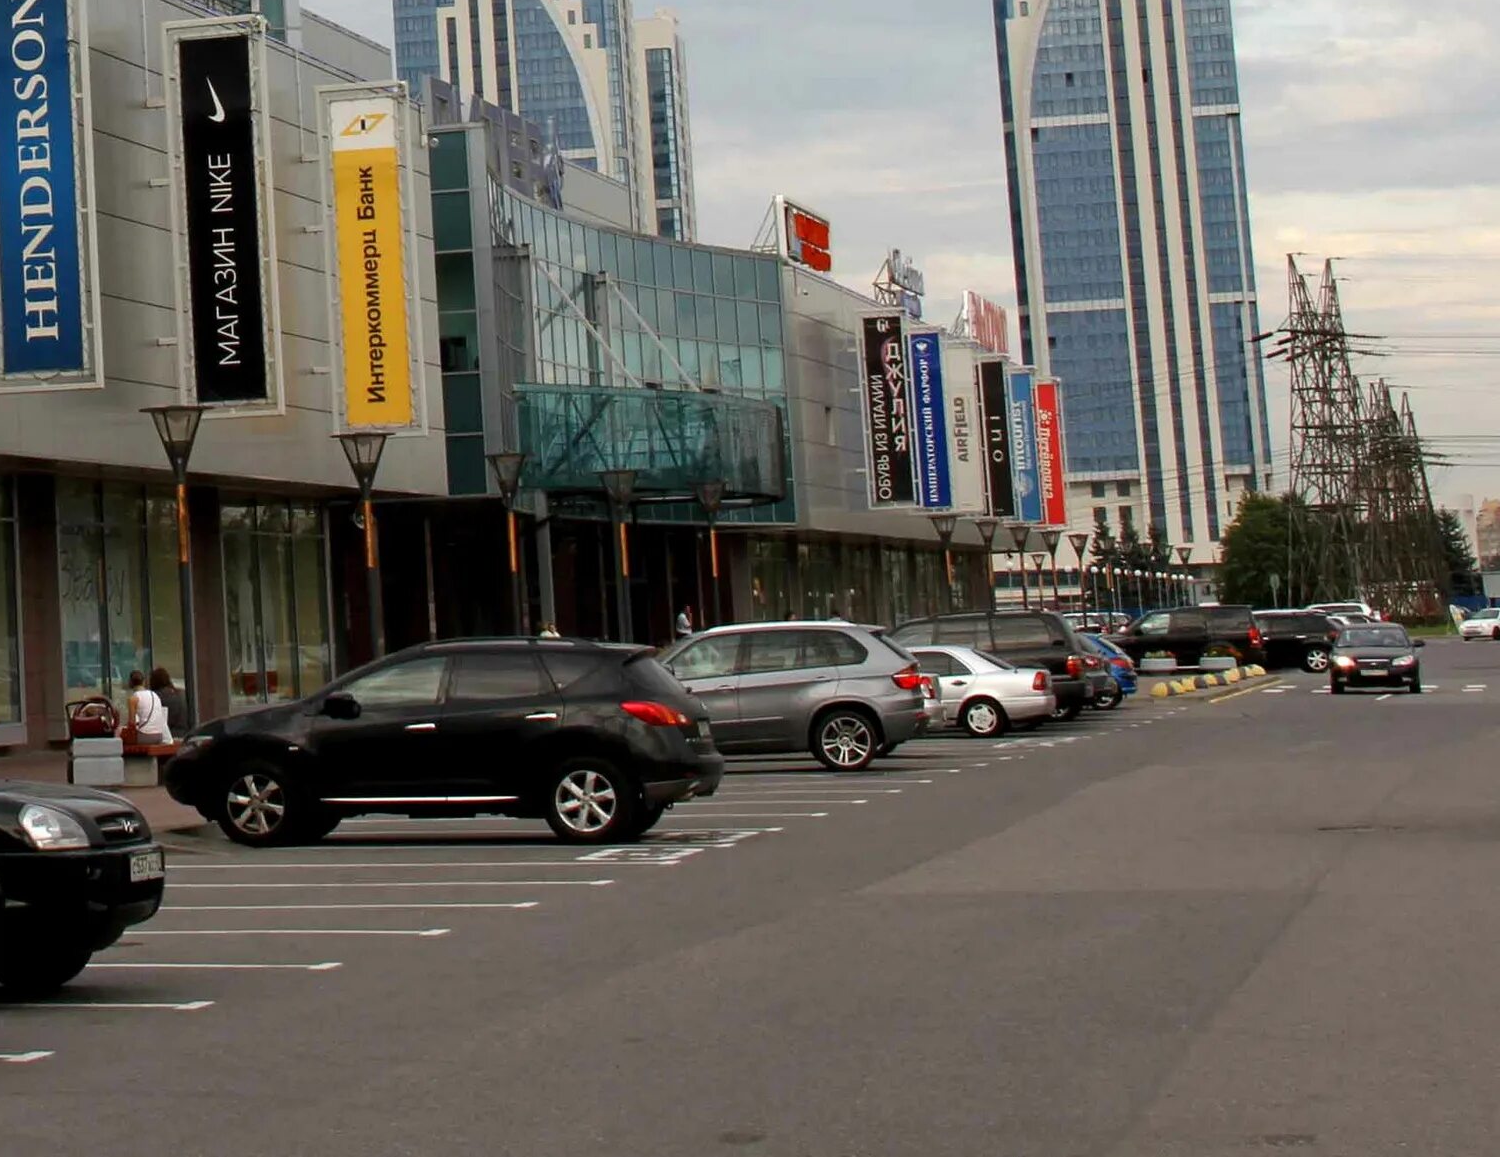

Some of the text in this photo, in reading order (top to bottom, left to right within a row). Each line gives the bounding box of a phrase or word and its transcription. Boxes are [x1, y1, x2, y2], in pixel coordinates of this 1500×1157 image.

[207, 153, 242, 366] МАГАЗИН NIKE
[355, 166, 388, 404] Интеркоммерц Банк
[870, 374, 892, 500] ОБУВЬ ИЗ ИТАЛИИ
[885, 342, 907, 452] ДЖУЛИЯ
[919, 358, 939, 503] ИМПЕРАТОРСКИЙ ФАРФОР
[954, 397, 969, 462] AIRFIELD
